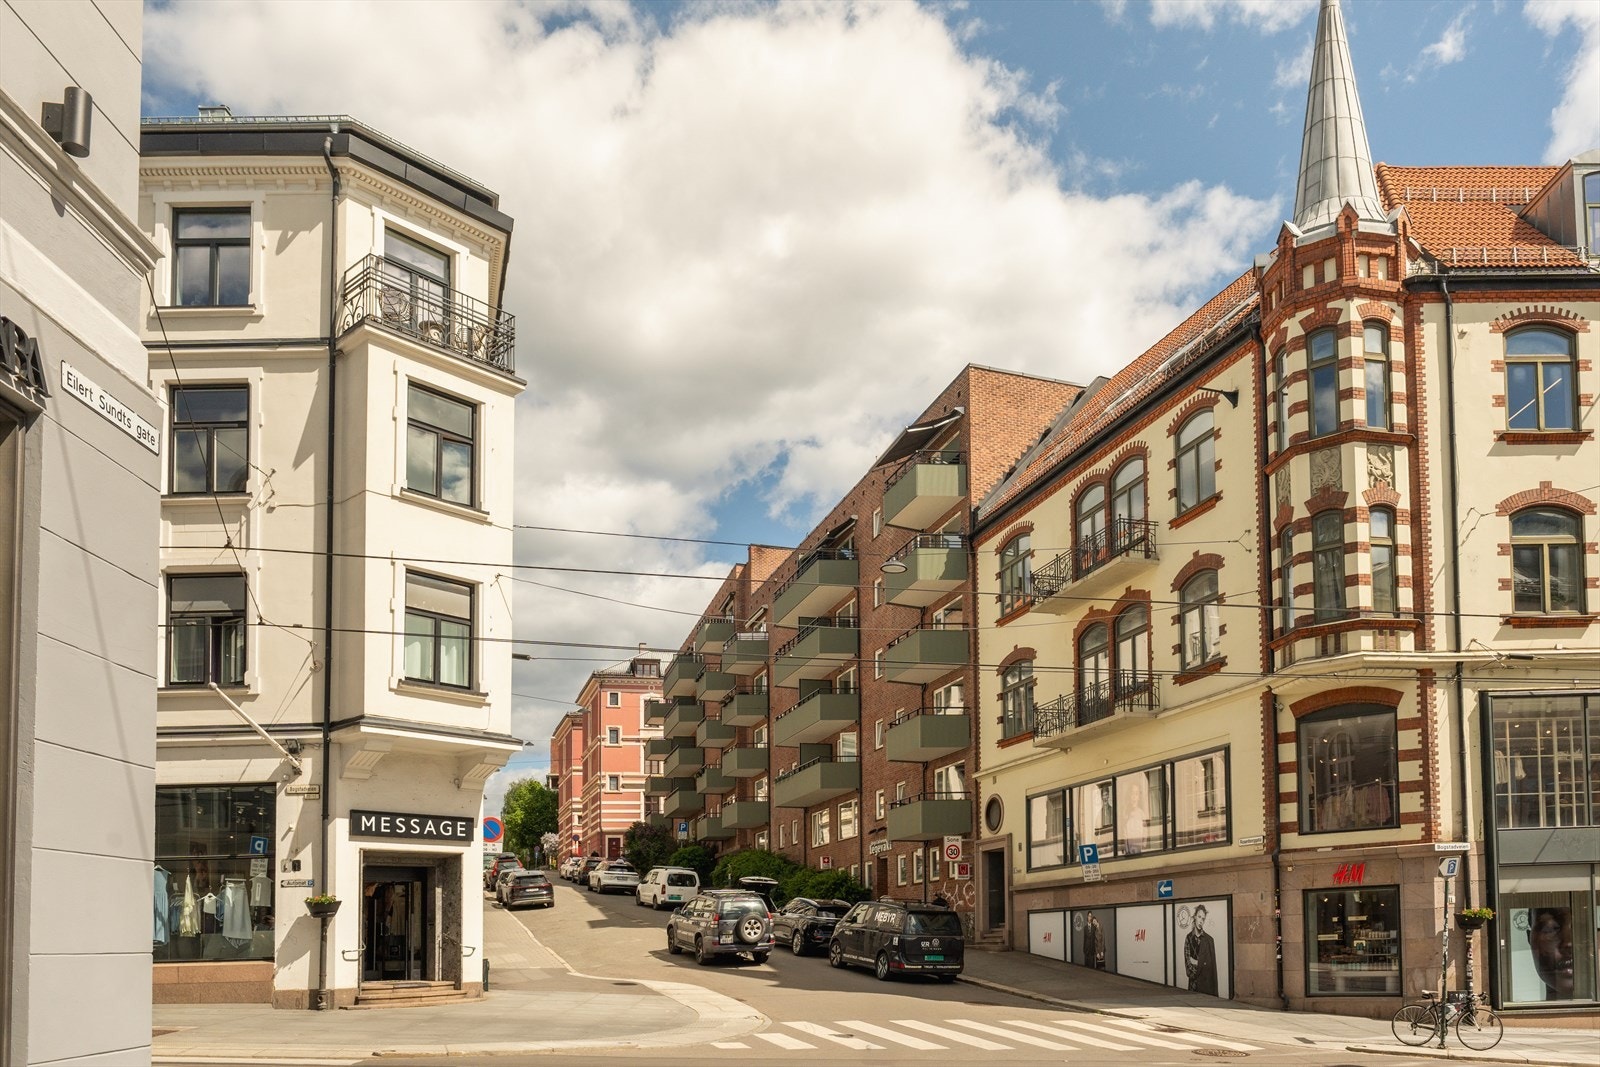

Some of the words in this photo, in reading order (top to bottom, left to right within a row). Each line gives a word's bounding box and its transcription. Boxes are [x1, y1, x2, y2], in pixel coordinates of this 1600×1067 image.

[66, 370, 94, 402] Eilert
[98, 394, 132, 429] Sundts
[136, 424, 156, 446] gate
[361, 815, 466, 837] MESSAGE
[948, 847, 958, 856] 30
[1083, 846, 1094, 862] P
[1333, 863, 1365, 884] H&M
